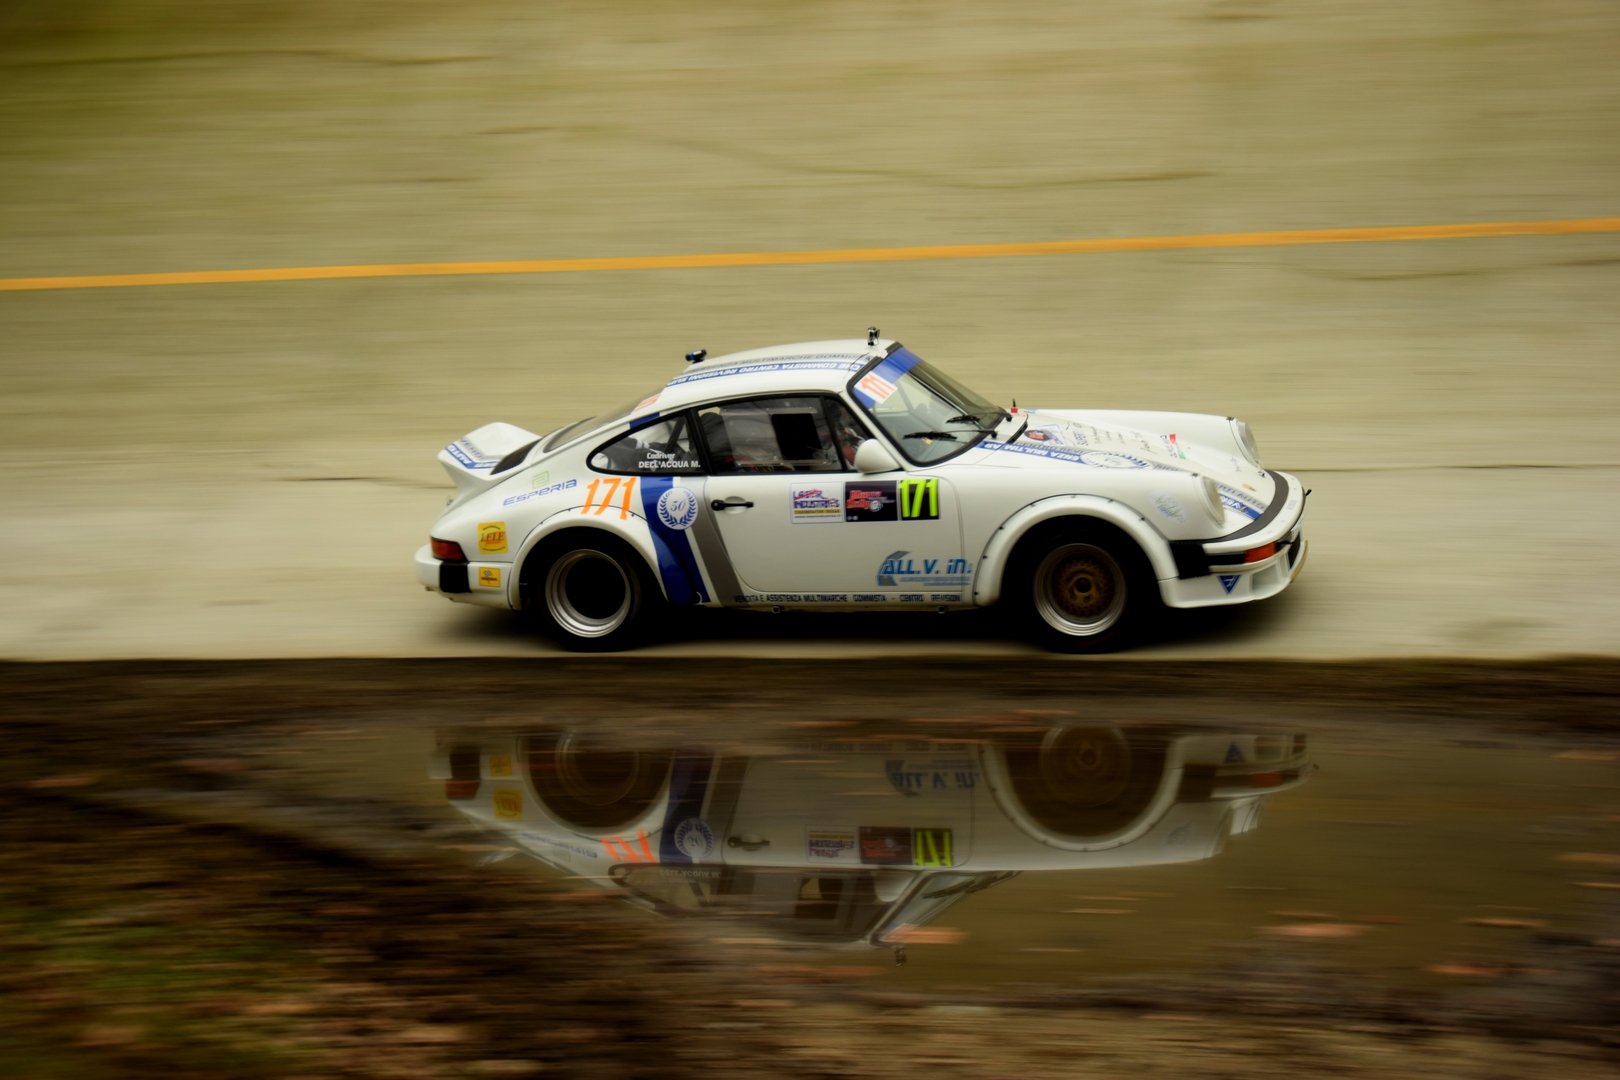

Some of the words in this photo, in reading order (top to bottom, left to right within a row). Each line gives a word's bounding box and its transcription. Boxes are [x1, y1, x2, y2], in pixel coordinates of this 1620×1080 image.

[638, 460, 689, 469] DELL'ACQUA
[690, 460, 701, 468] M.
[502, 479, 578, 506] ESPERIA
[580, 476, 637, 520] 171
[670, 500, 686, 512] 50
[898, 477, 939, 518] 171
